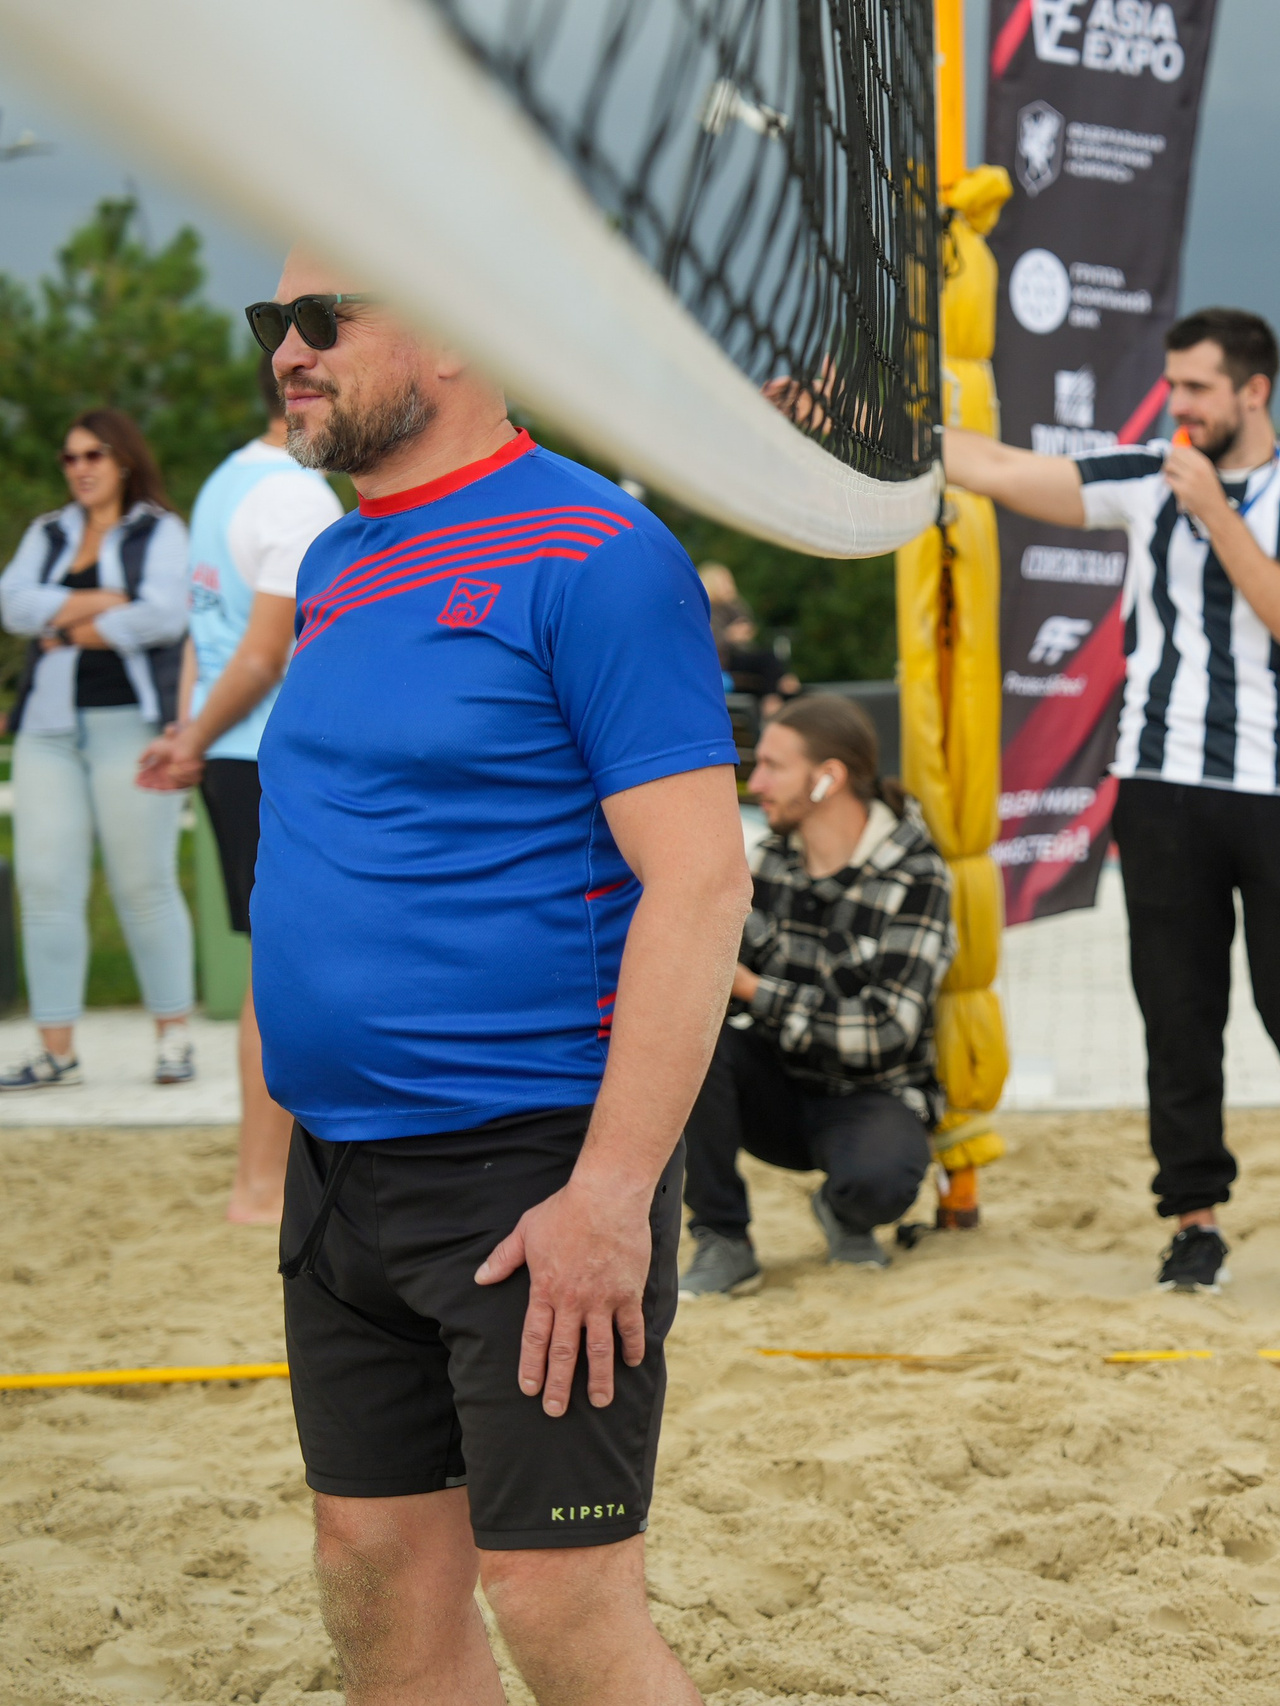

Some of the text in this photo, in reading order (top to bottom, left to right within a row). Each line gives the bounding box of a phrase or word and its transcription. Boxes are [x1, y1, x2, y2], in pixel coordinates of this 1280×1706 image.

[1087, 0, 1178, 41] ASIA
[1083, 30, 1185, 82] EXPO
[551, 1504, 626, 1521] KIPSTA
